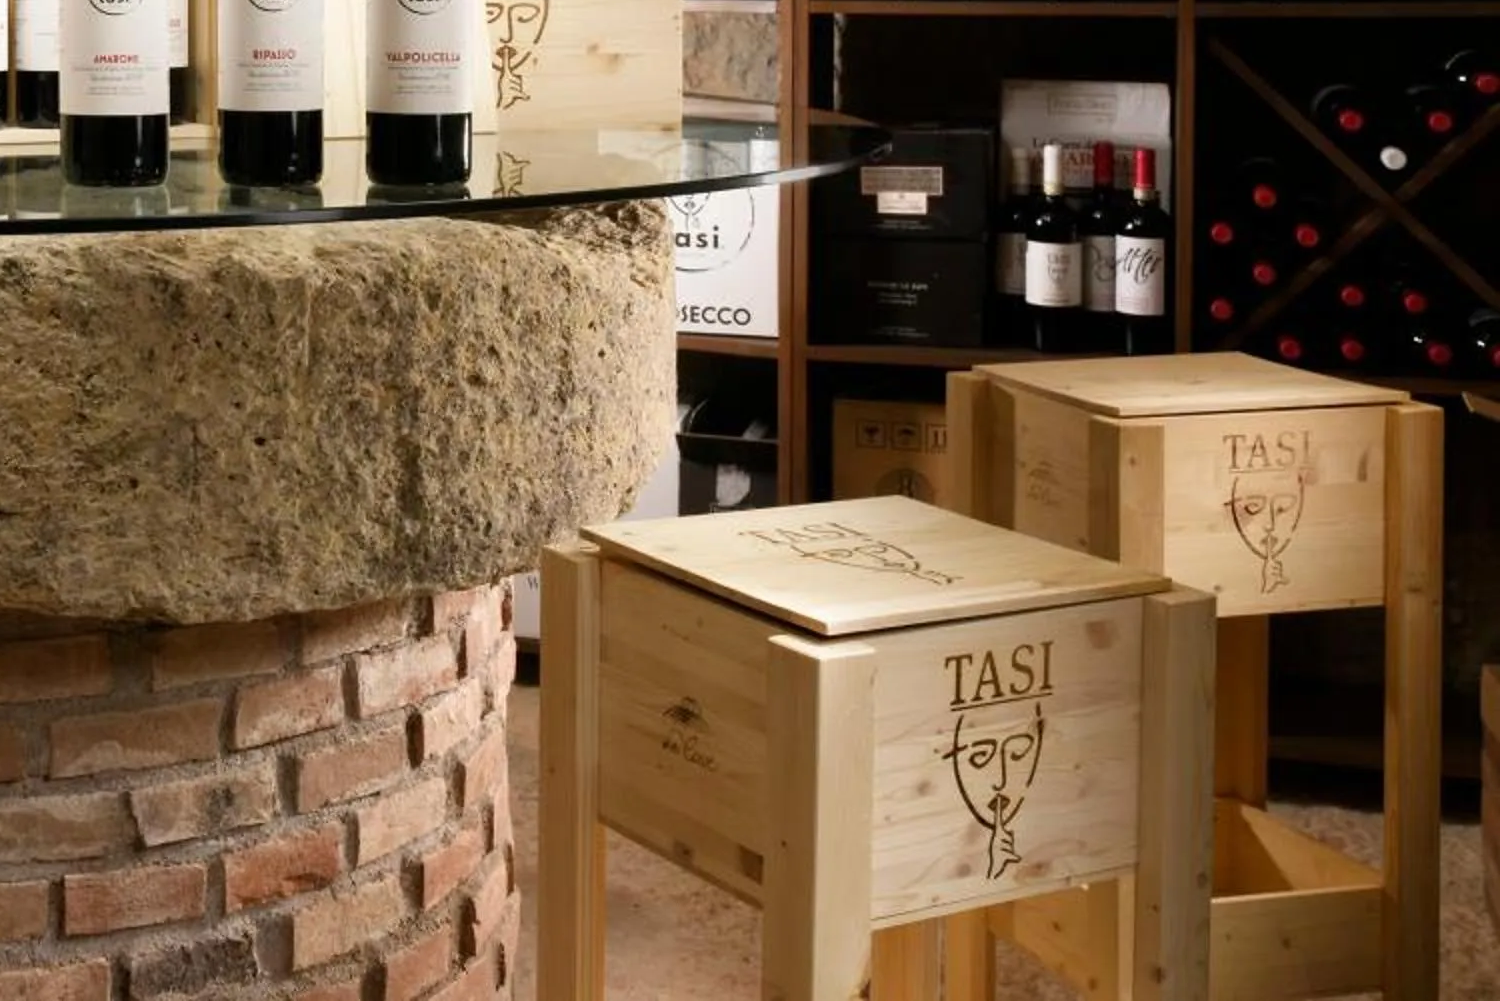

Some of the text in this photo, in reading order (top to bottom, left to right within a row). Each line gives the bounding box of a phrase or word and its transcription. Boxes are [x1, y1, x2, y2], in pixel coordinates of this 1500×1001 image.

[385, 52, 460, 63] VALPOLICELLA
[675, 225, 719, 249] asi
[677, 305, 751, 326] SECCO
[1222, 431, 1312, 470] TASI
[738, 522, 872, 544] TASI
[945, 641, 1056, 707] TASI
